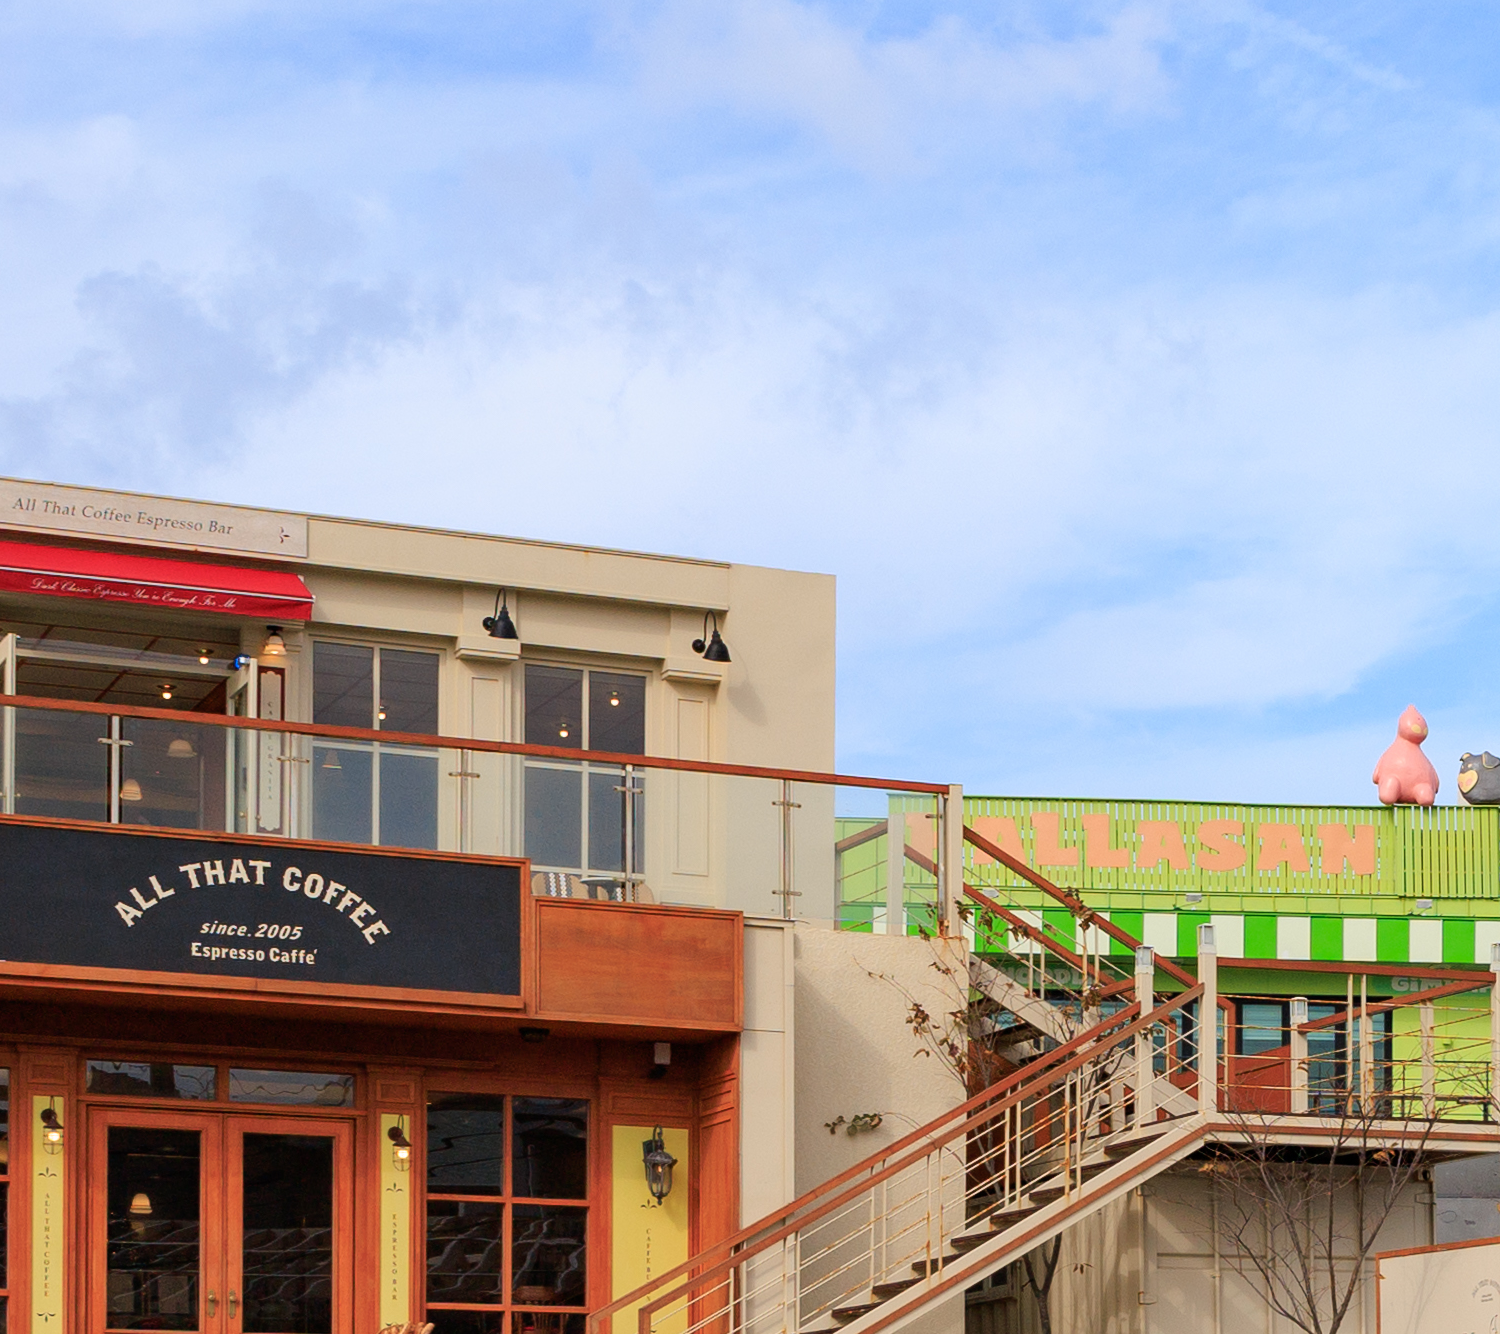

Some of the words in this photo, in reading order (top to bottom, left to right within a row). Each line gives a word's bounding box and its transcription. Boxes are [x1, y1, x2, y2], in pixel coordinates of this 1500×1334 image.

[12, 497, 37, 511] All
[43, 500, 76, 517] That
[82, 505, 132, 523] Coffee
[137, 511, 203, 531] Espresso
[208, 520, 234, 535] Bar
[114, 875, 175, 928] ALL
[178, 858, 272, 889] THAT
[283, 866, 391, 945] COFFEE
[191, 942, 266, 963] Espresso
